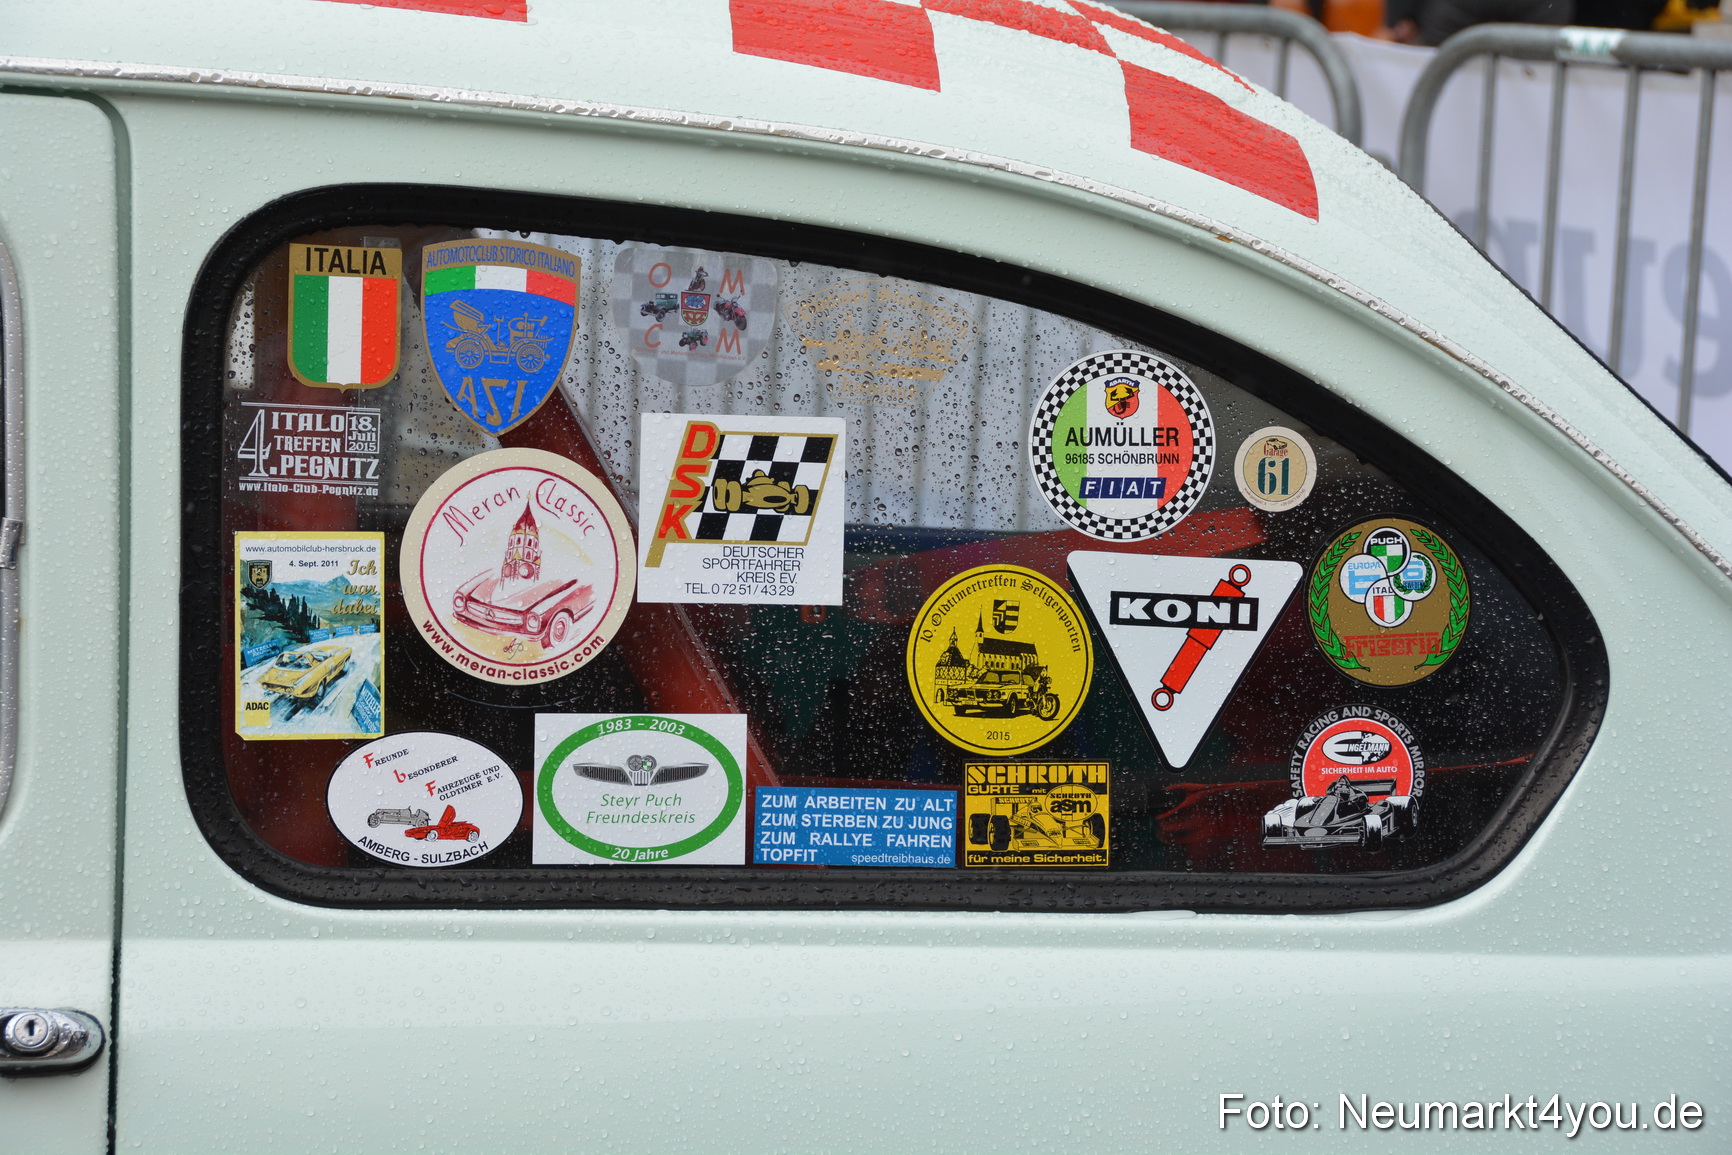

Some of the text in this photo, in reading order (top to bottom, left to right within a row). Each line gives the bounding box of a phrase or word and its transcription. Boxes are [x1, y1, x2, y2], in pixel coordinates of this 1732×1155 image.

[306, 247, 387, 275] ITALIA
[426, 245, 575, 277] AUTOMOTOCLUB STORICO ITALIANO
[648, 262, 745, 296] O M
[644, 323, 664, 348] C
[715, 328, 742, 354] M
[1109, 379, 1135, 387] ABARTH
[457, 377, 528, 426] ASI
[271, 411, 345, 433] ITALO
[348, 415, 377, 431] 18.
[348, 430, 376, 442] Juli
[1065, 422, 1180, 447] AUMÜLLER
[274, 435, 341, 454] TREFFEN
[348, 442, 377, 452] 2015
[1263, 443, 1289, 457] Garage
[1065, 450, 1180, 465] 96185 SCHÖNBRUNN
[280, 455, 380, 480] PEGNITZ
[1257, 456, 1291, 496] 61
[239, 482, 379, 497] www.Italo-Club-Pegnitz.de
[657, 424, 716, 539] DSK
[1084, 480, 1162, 496] FIAT
[442, 478, 595, 547] Meran Classic
[245, 545, 377, 554] www.automobilclub-hersbruck.de
[1370, 537, 1403, 545] PUCH
[722, 546, 805, 559] DEUTSCHER
[298, 560, 320, 569] Sept.
[347, 559, 377, 576] Ich
[702, 558, 801, 571] SPORTFAHRER
[1347, 561, 1381, 570] EUROPA
[736, 572, 798, 584] KREIS EV.
[1403, 580, 1424, 589] SWEDEN
[342, 584, 377, 595] war
[331, 599, 378, 615] dabei
[931, 574, 1017, 626] Oldtimertreffen
[1020, 578, 1081, 653] Seligenporten
[1118, 597, 1251, 625] KONI
[422, 619, 605, 680] www.meran-classic.com
[245, 702, 269, 711] ADAC
[598, 718, 632, 736] 1983
[649, 719, 686, 736] 2003
[986, 731, 1010, 741] 2015
[1290, 706, 1425, 798] SAFETY RACING AND SPORTS MIRROR
[1322, 731, 1390, 765] ENGELMANN
[362, 748, 409, 769] FREUNDE
[967, 765, 1107, 784] SCHROTH
[1321, 766, 1363, 775] SICHERHEIT
[1365, 766, 1375, 774] IM
[425, 765, 500, 796] FAHRZEUGE UND
[439, 774, 504, 801] OLDTIMER E.V.
[967, 785, 1020, 794] GURTE
[600, 793, 682, 809] Steyr Puch
[761, 795, 954, 812] ZUM ARBEITEN ZU ALT
[1050, 799, 1092, 813] asm
[586, 811, 696, 824] Freundeskreis
[761, 813, 953, 830] ZUM STERBEN ZU JUNG
[760, 831, 952, 848] ZUM RALLYE FAHREN
[358, 836, 410, 862] AMBERG
[421, 841, 489, 864] SULZBACH
[612, 847, 669, 862] 20 Jahre
[760, 848, 951, 865] TOPFIT speedtreibhaus.de
[968, 853, 1106, 863] für meine Sicherheit.
